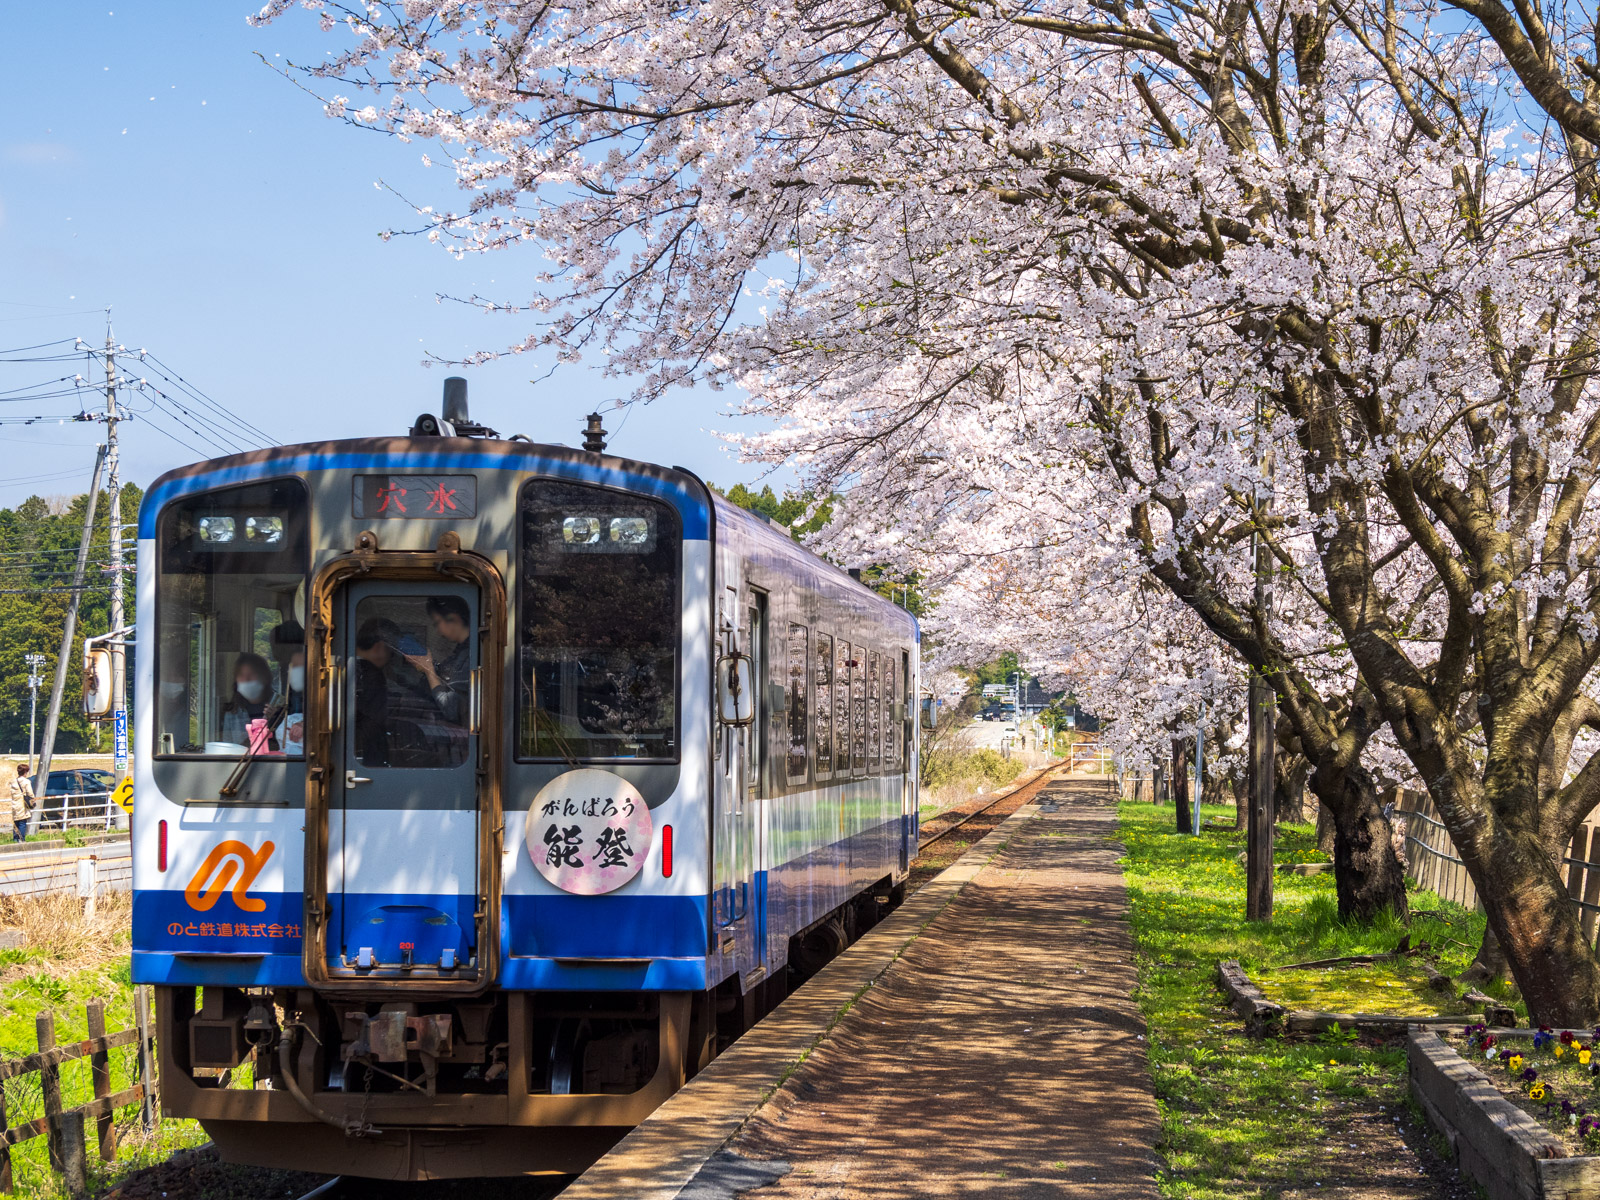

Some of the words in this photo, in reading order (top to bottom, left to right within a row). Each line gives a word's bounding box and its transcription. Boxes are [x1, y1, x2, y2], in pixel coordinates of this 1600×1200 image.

[376, 482, 457, 514] 穴水
[541, 797, 635, 818] がんばろう
[543, 823, 634, 869] 能登
[167, 921, 302, 938] のと鉄道株式会社
[399, 942, 415, 950] 201
